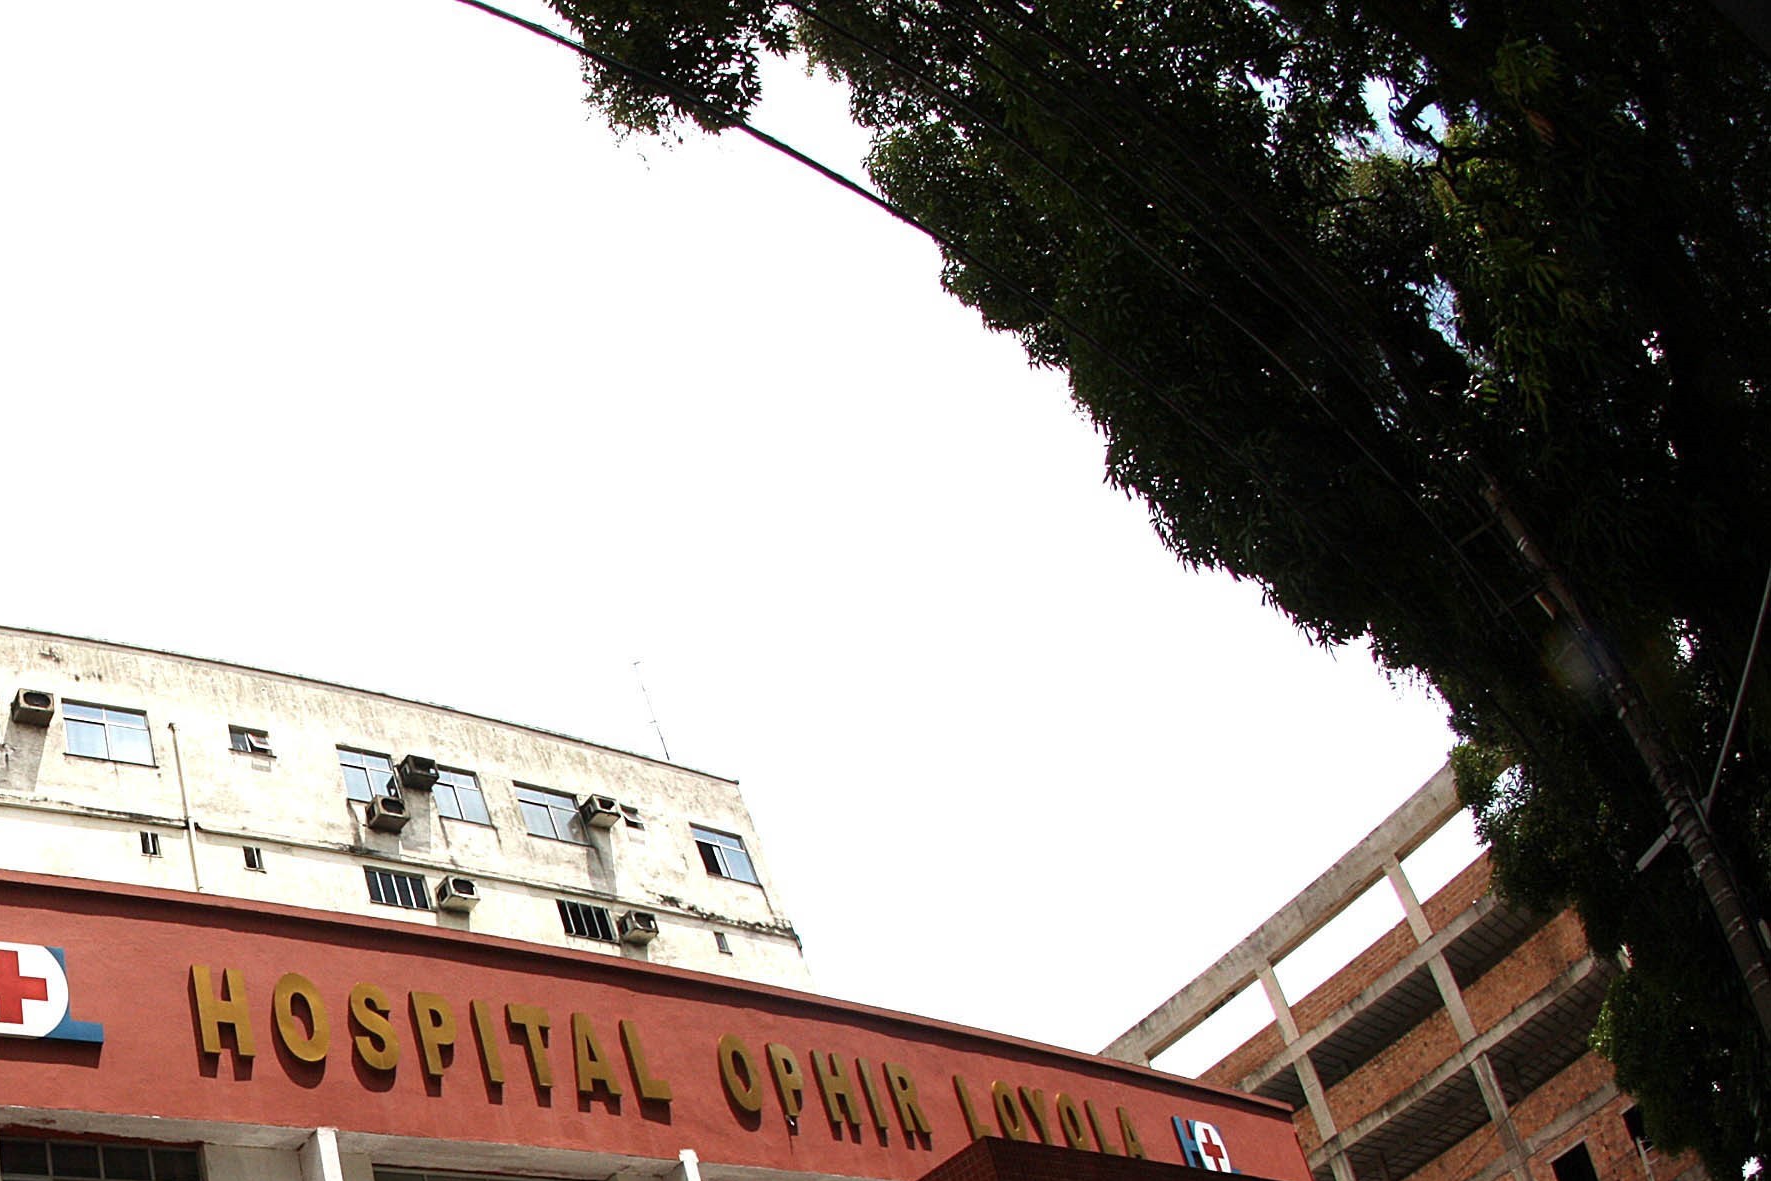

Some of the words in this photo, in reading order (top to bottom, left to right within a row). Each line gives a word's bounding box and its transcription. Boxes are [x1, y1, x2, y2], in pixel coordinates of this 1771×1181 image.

[189, 964, 672, 1103] HOSPITAL
[717, 1033, 933, 1136] OPHIR
[953, 1074, 1148, 1159] LOYOLA
